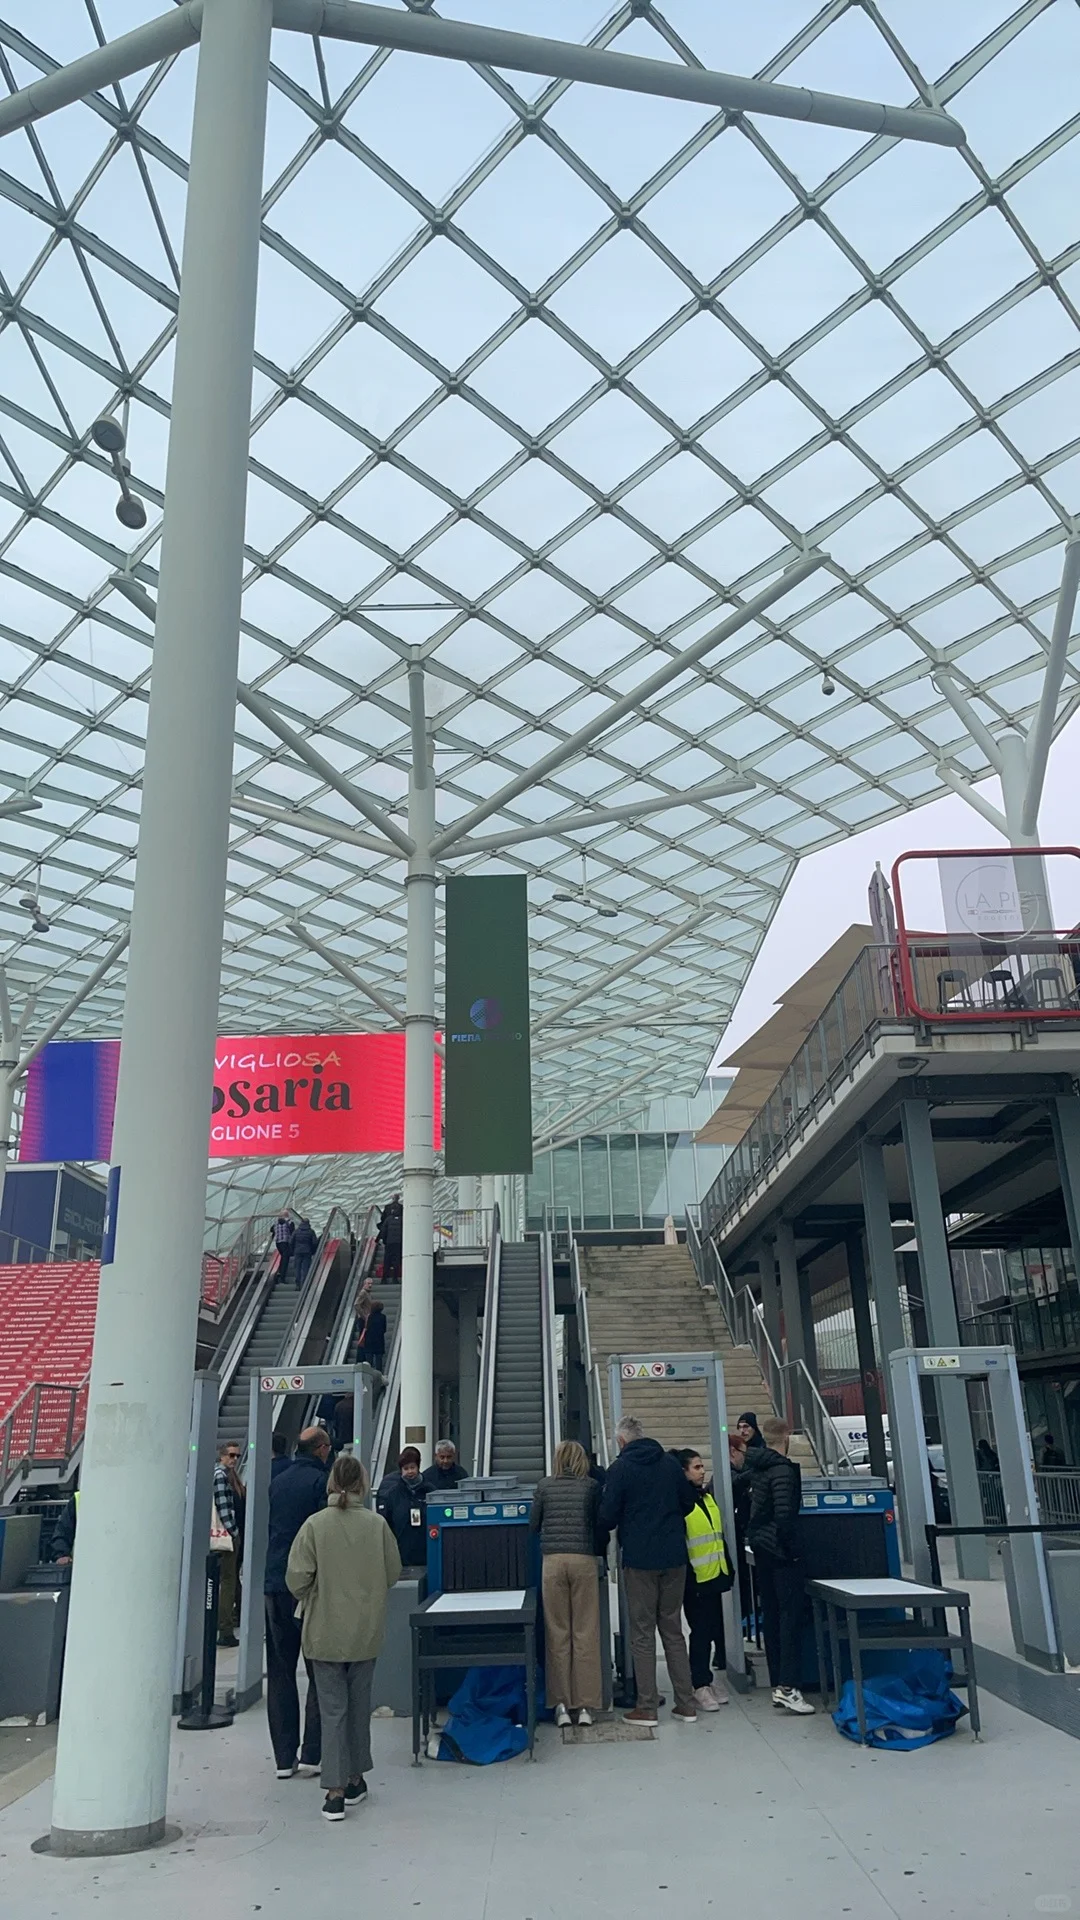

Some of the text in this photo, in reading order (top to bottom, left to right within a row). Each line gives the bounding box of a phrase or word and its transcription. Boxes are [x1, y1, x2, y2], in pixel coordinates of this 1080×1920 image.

[964, 892, 992, 908] LA
[214, 1051, 341, 1072] VIGLIOSA
[211, 1123, 300, 1141] GLIONE 5
[206, 1578, 214, 1610] SECURITY
